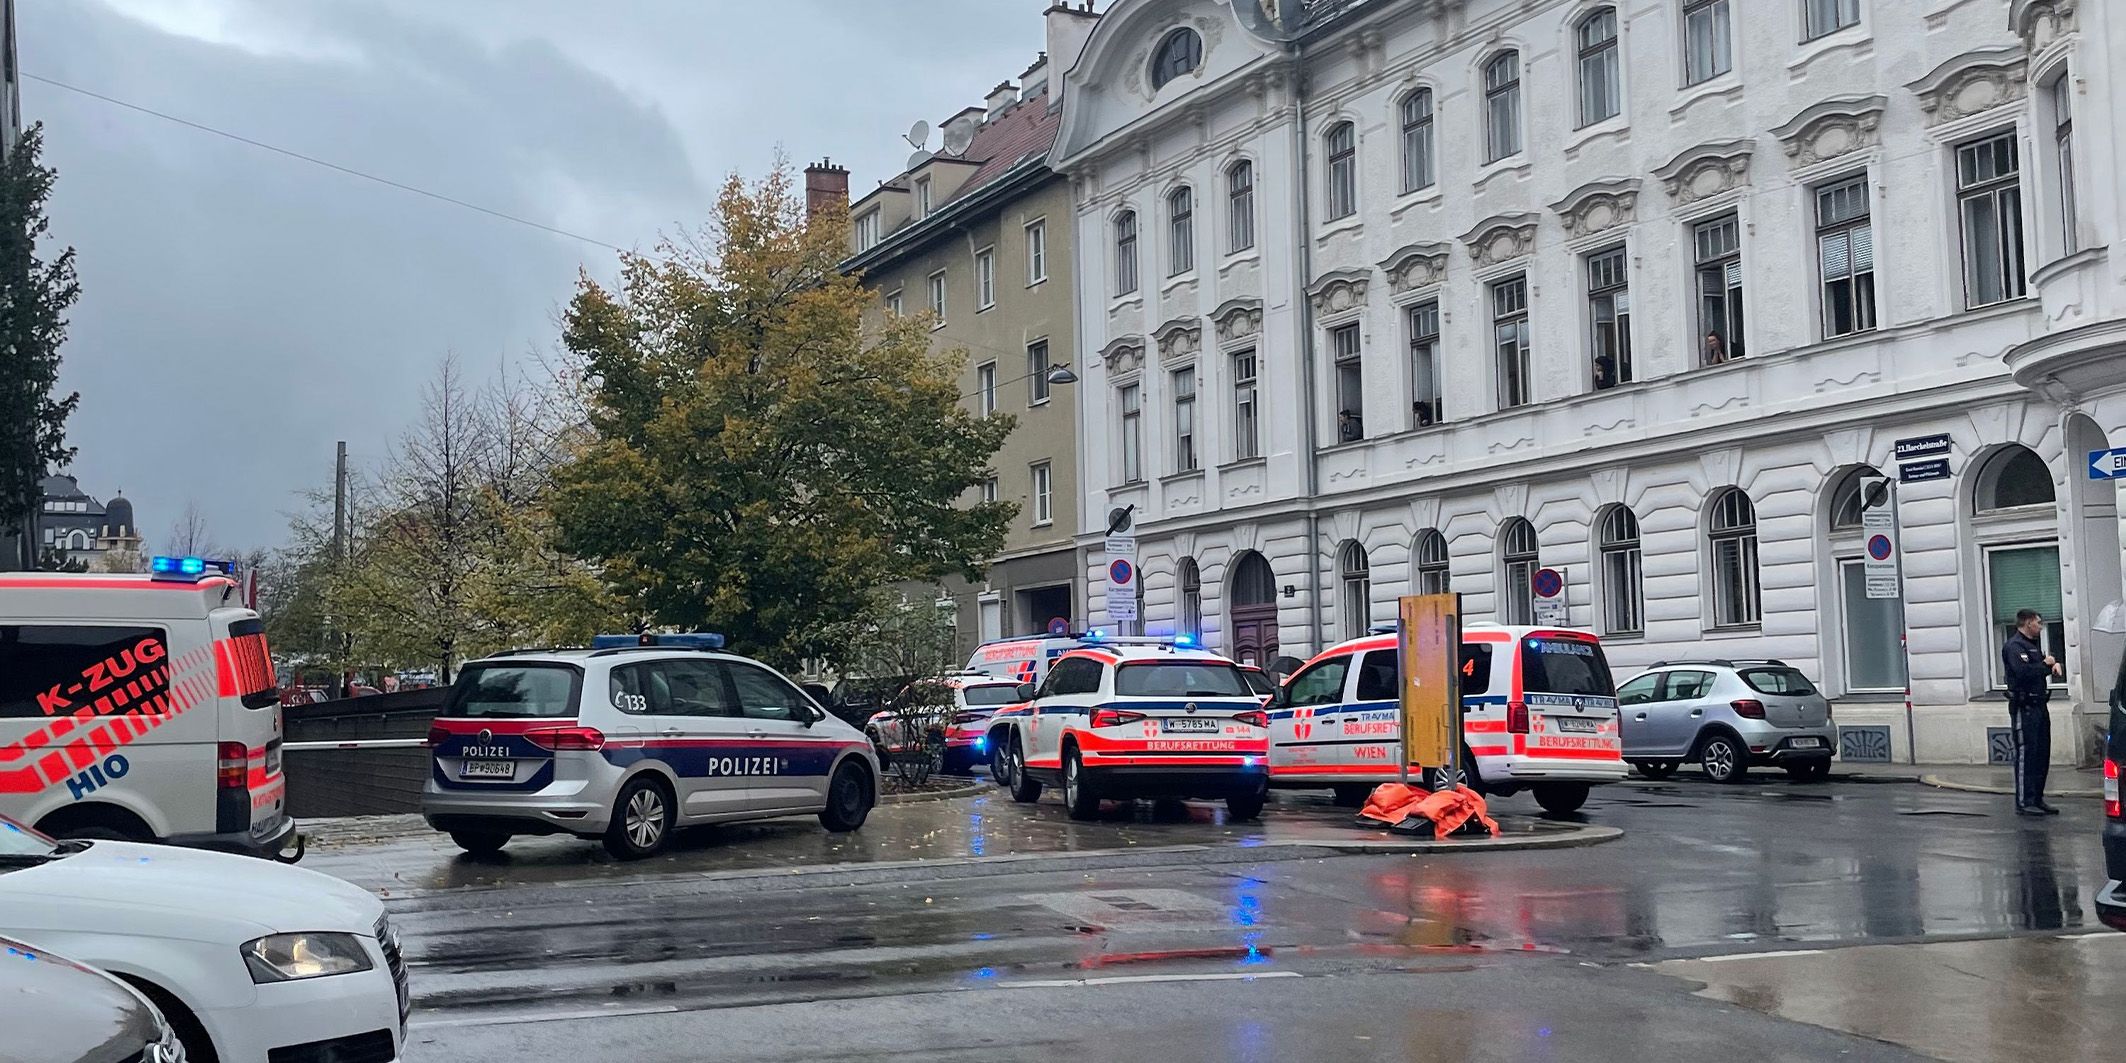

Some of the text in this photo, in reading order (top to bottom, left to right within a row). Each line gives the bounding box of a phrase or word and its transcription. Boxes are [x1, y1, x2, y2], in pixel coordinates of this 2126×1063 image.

[36, 638, 166, 716] K-ZUG
[625, 694, 647, 711] 133
[1147, 741, 1235, 751] BERUFSRETTUNG
[1539, 736, 1613, 748] BERUFSRETTUNG
[463, 746, 509, 757] POLIZEI
[1354, 746, 1387, 759] WIEN
[708, 757, 778, 776] POLIZEI
[66, 754, 130, 801] HIO
